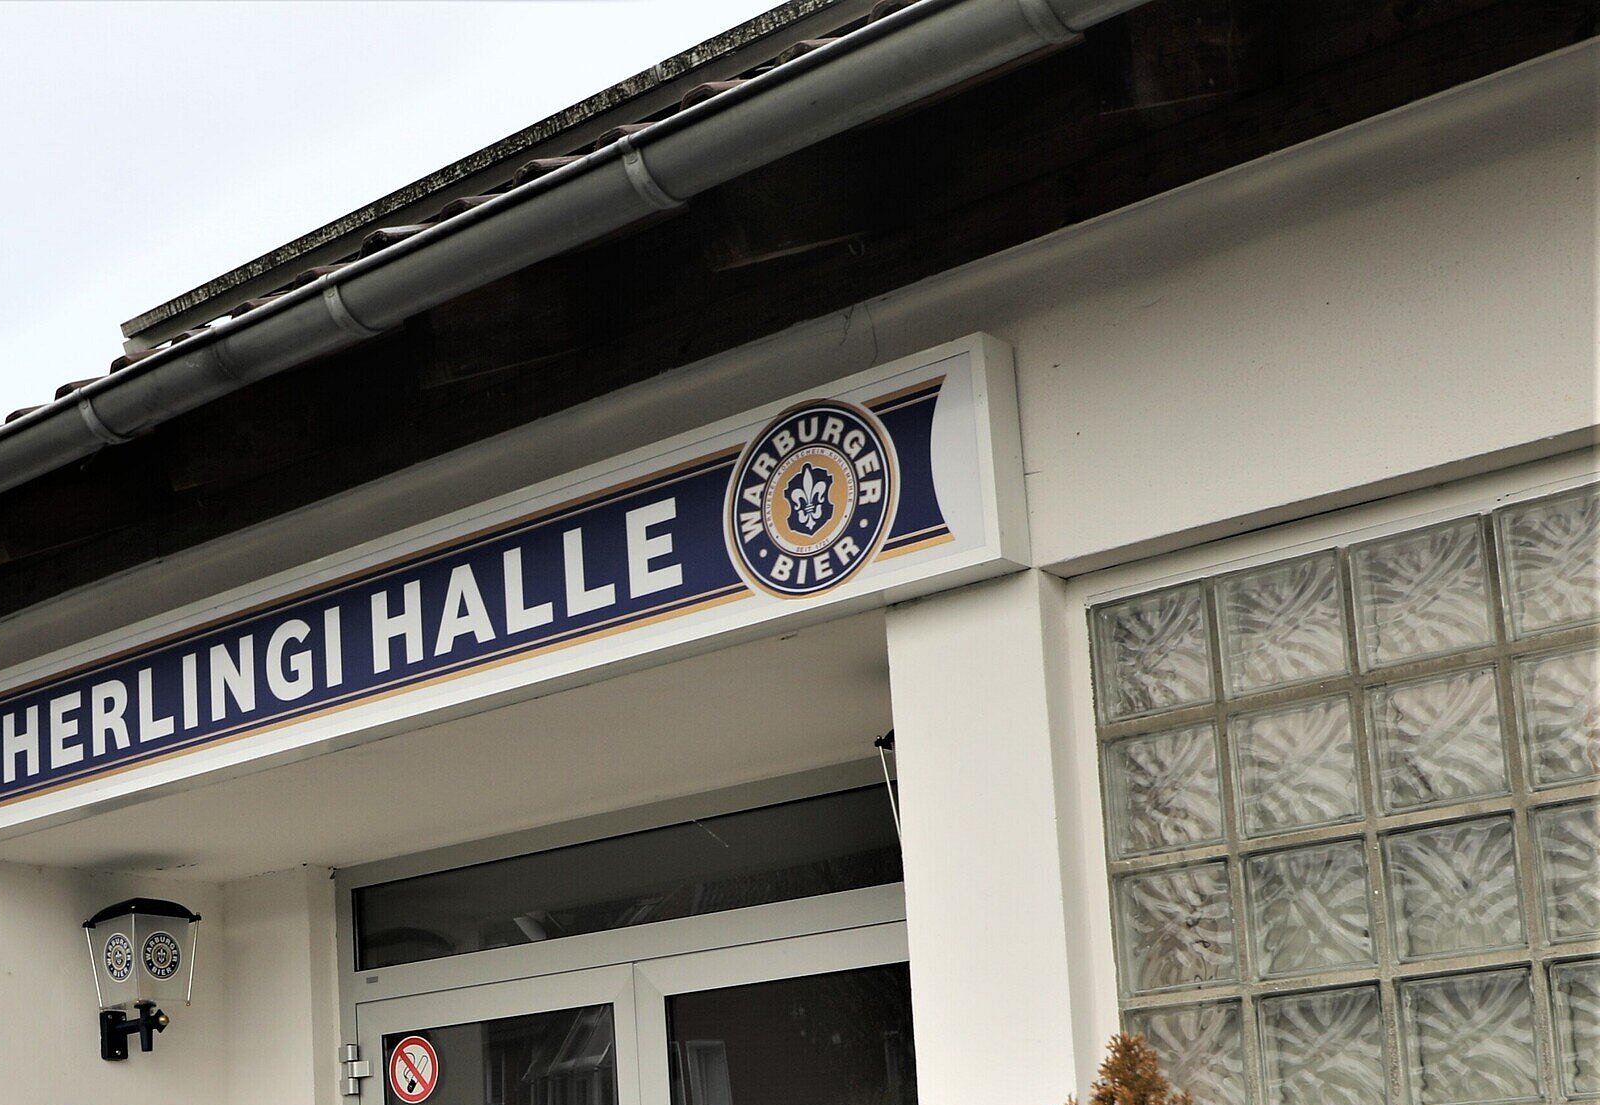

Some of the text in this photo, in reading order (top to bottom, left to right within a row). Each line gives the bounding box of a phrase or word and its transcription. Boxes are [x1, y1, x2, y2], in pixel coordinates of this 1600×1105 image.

[739, 416, 883, 543] WARBURGER
[771, 536, 861, 584] BIER
[2, 497, 684, 783] HERLINGI HALLE
[146, 936, 178, 962] WARBURGER
[113, 967, 129, 977] BIER
[151, 967, 172, 976] BIER
